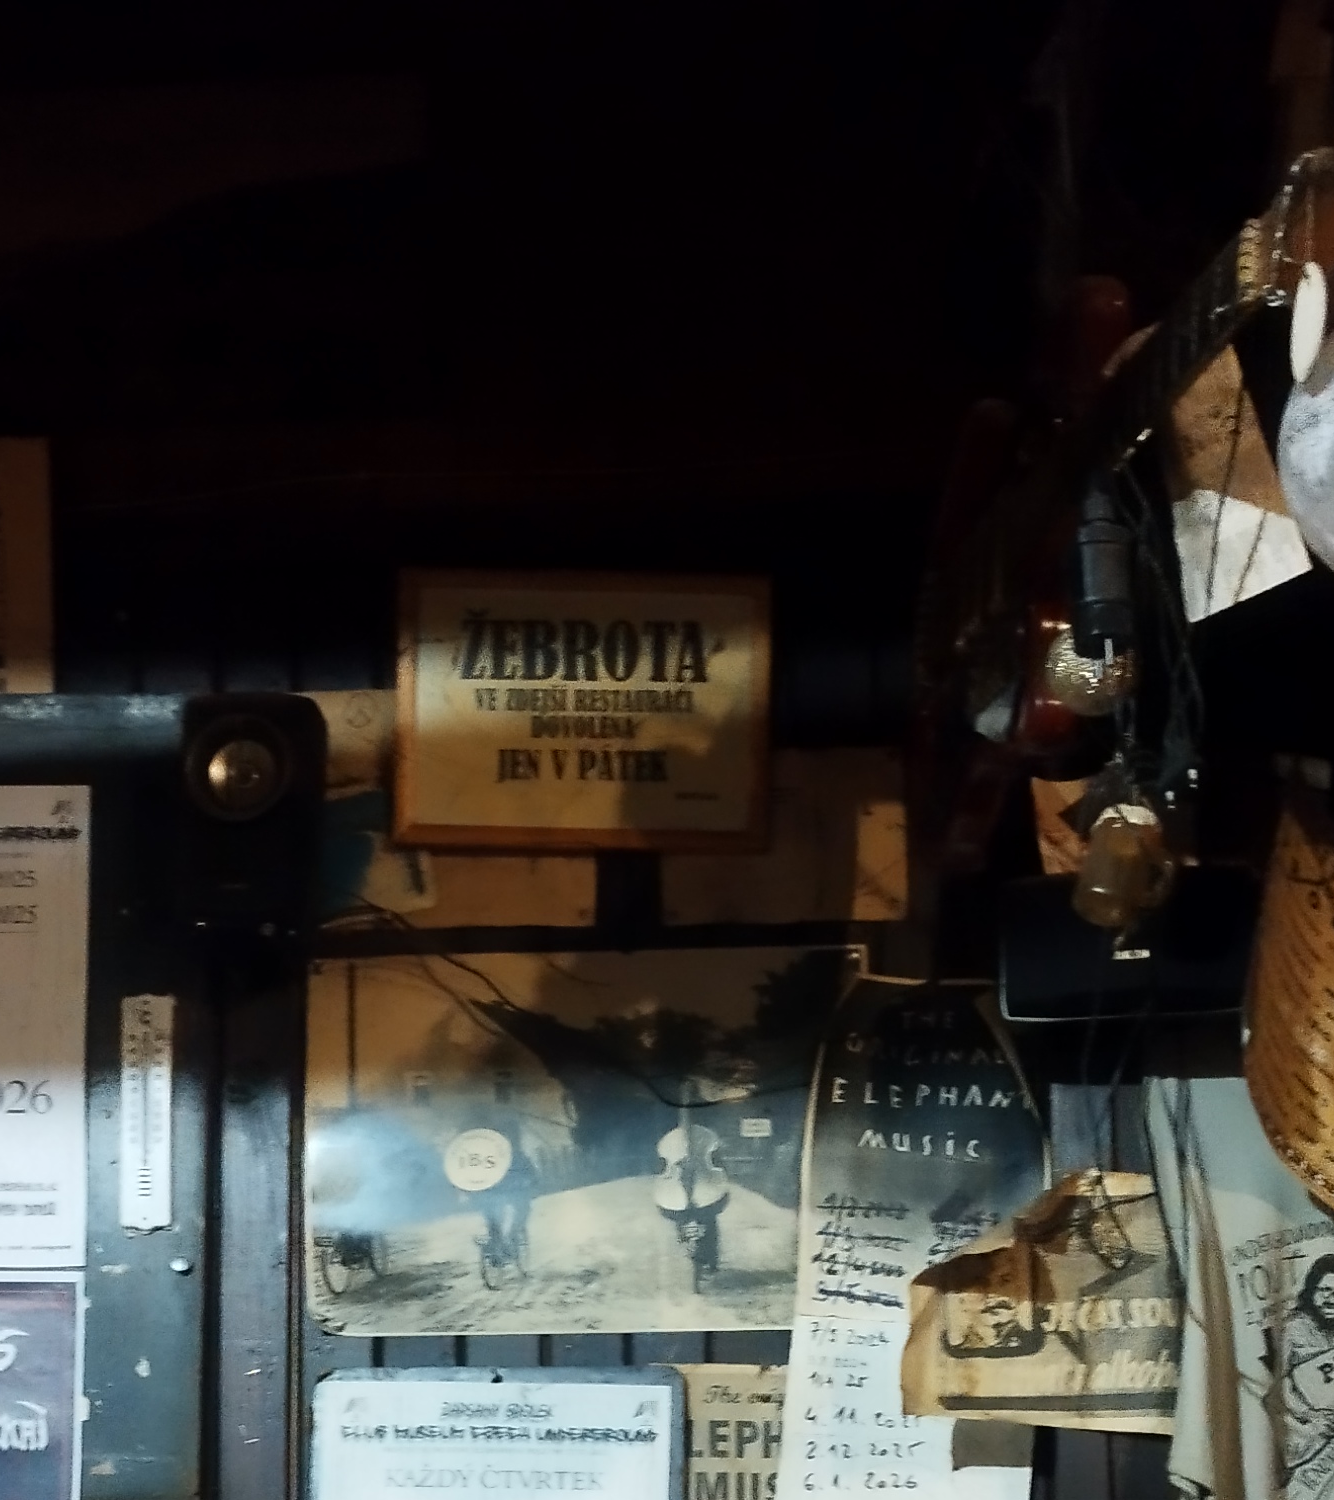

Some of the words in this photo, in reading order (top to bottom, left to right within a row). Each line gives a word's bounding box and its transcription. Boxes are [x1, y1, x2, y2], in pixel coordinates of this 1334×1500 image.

[459, 608, 709, 684] ŽEBROTA
[497, 749, 540, 783] JEN
[550, 749, 567, 781] V
[687, 1419, 784, 1459] LEPH
[384, 1462, 476, 1489] KAŽDÝ
[479, 1462, 606, 1491] ČTVRTEK
